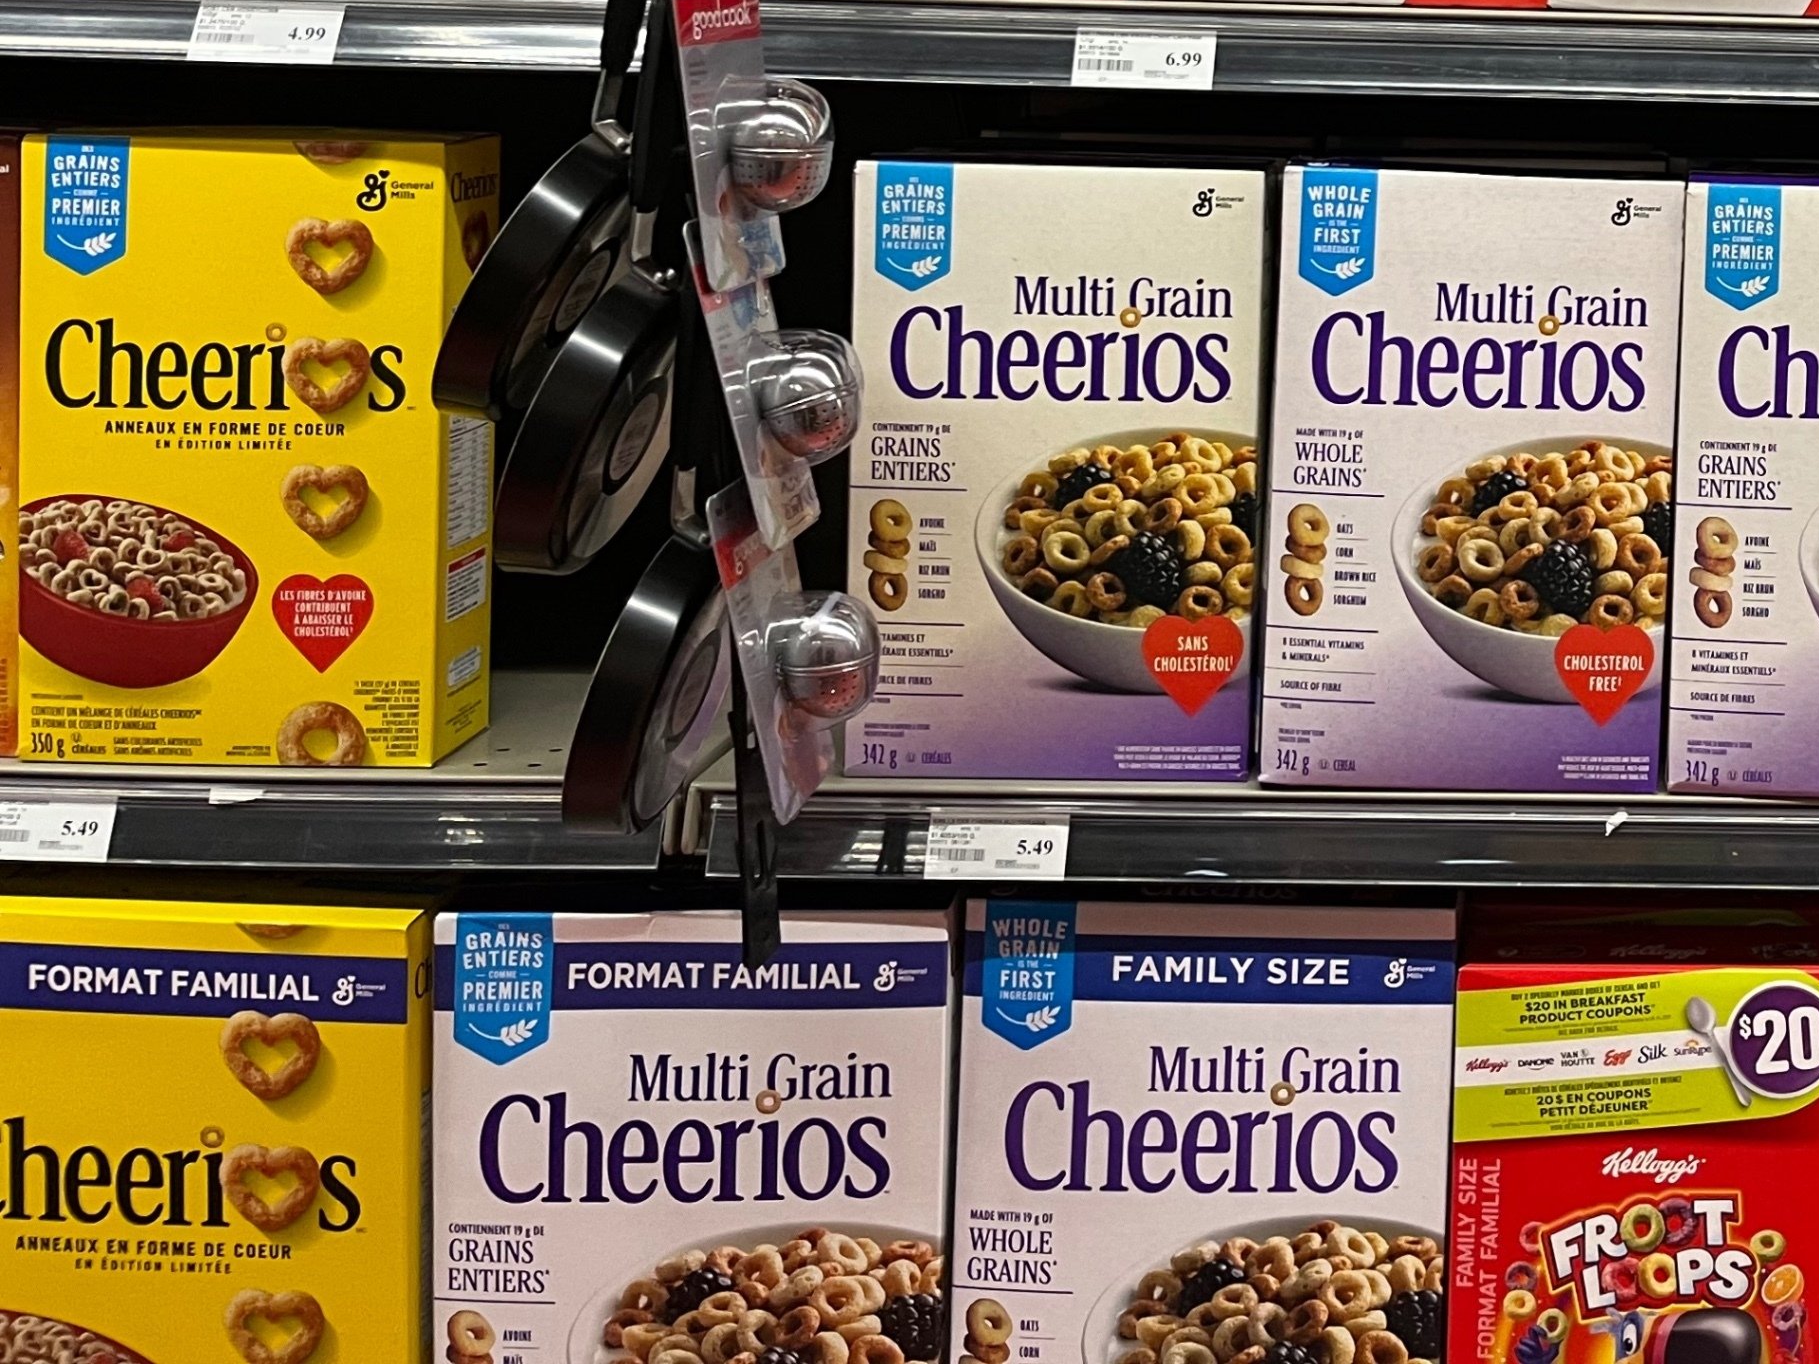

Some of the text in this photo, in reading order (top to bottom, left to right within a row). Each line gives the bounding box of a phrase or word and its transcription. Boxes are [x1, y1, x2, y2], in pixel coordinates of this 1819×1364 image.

[288, 26, 325, 42] 4.99
[1166, 51, 1201, 68] 6.99
[1014, 276, 1232, 318] Multi Grain
[1435, 283, 1648, 327] Multi Grain
[890, 305, 1231, 403] Cheerios
[1312, 311, 1646, 412] Cheerios
[105, 421, 345, 436] ANNEAUX EN FORME DE COEUR
[61, 821, 98, 836] 5.49
[1017, 840, 1053, 855] 5.49
[28, 964, 319, 1001] FORMAT FAMILIAL
[569, 962, 860, 990] FORMAT FAMILIAL
[1113, 956, 1349, 984] FAMILY SIZE
[628, 1052, 892, 1102] Multi Grain
[1148, 1046, 1401, 1093] Multi Grain
[479, 1092, 890, 1204] Cheerios
[1005, 1081, 1398, 1194] Cheerios
[1602, 1147, 1701, 1183] Kellogg's
[1551, 1198, 1733, 1278] FROOT
[1584, 1249, 1752, 1308] LOOPS
